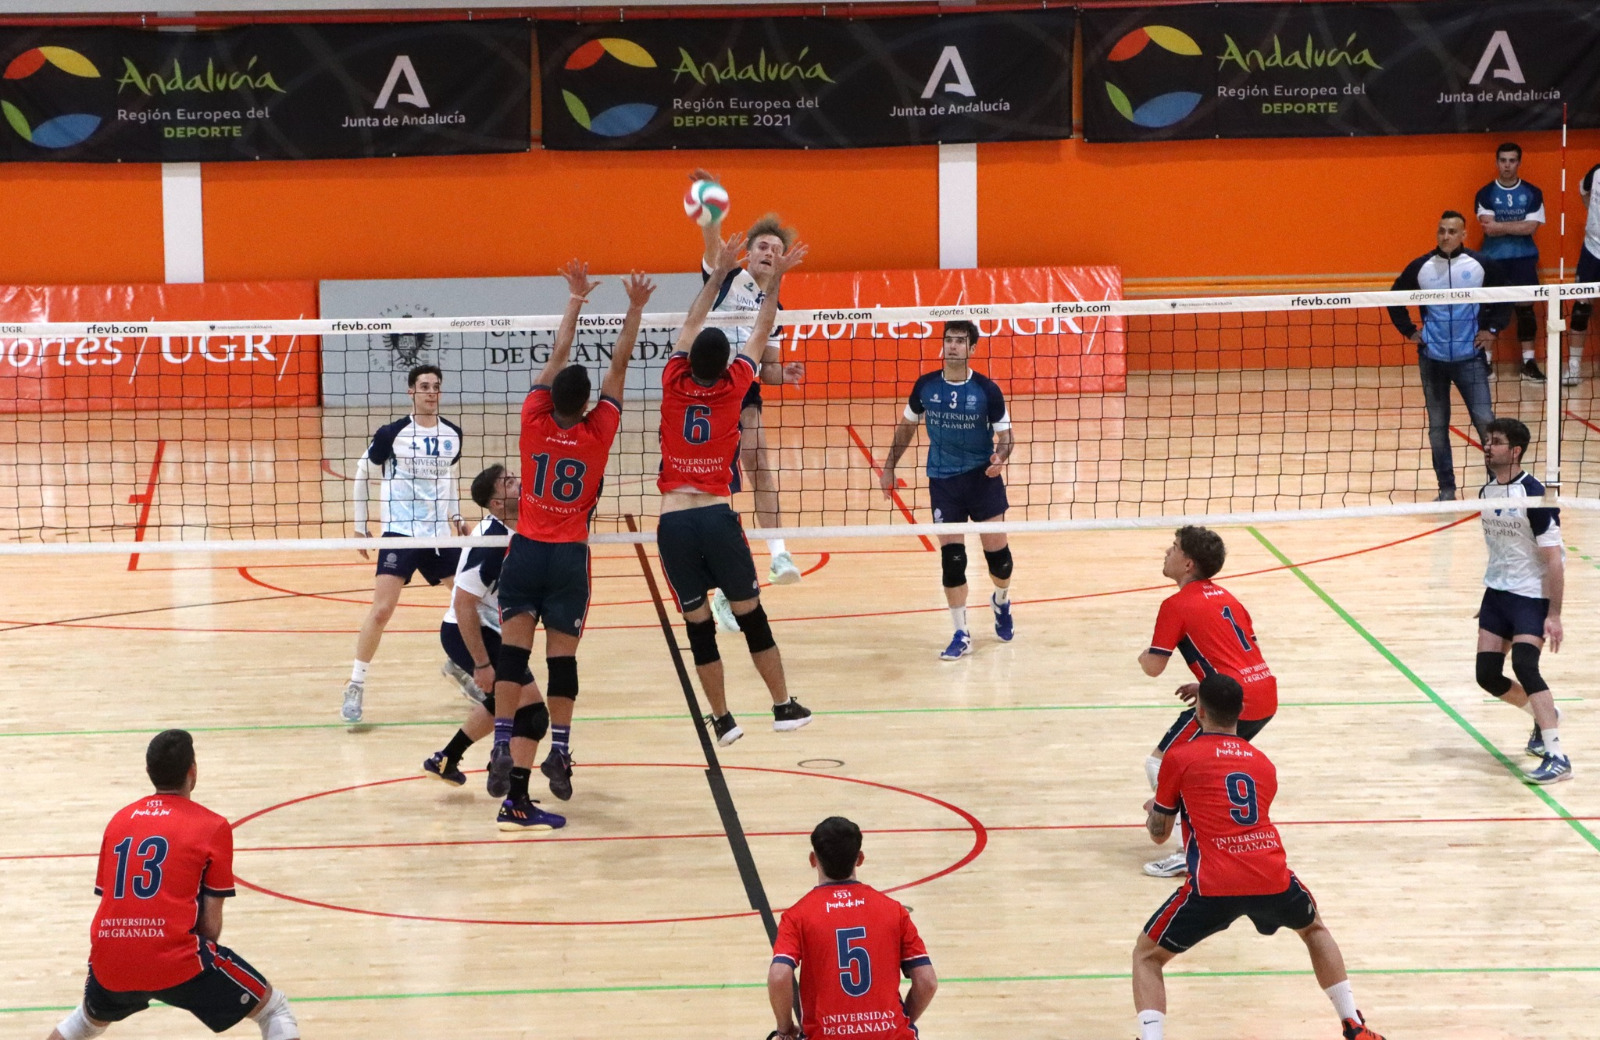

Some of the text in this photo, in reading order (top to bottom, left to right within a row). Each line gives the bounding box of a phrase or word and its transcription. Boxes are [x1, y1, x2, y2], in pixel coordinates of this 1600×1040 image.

[1216, 32, 1384, 73] Andalucía
[671, 46, 836, 86] Andalucía
[116, 55, 287, 97] Andalucía
[1217, 83, 1367, 100] Región Europea del
[1437, 86, 1561, 104] Junta de Andalucía
[673, 96, 820, 114] Región Europea del
[890, 99, 1011, 118] Junta de Andalucía
[1261, 102, 1338, 114] DEPORTE
[117, 105, 270, 124] Región Europea del
[341, 110, 466, 129] Junta de Andalucía
[674, 114, 792, 128] DEPORTE 2021
[163, 125, 242, 139] DEPORTE
[1410, 291, 1471, 300] deportes UGR
[1534, 285, 1594, 297] rfeb.com
[1290, 295, 1351, 306] rfevb.com
[813, 311, 872, 321] rfevb.com
[929, 307, 990, 317] deportes UGR
[1051, 303, 1111, 314] rfevb.com
[87, 324, 148, 334] rfevb.com
[331, 321, 392, 332] rfevb.com
[450, 318, 511, 329] deportes UGR
[579, 316, 626, 327] fevb.co
[0, 335, 278, 368] ortes UGR
[490, 347, 524, 364] DE
[949, 391, 958, 409] 3
[683, 404, 711, 445] 6
[424, 437, 440, 456] 12
[668, 455, 724, 466] UNIVERSIDAD
[531, 452, 587, 502] 18
[1221, 606, 1251, 652] 1
[1225, 771, 1258, 826] 9
[1228, 840, 1280, 854] GRANADA
[113, 835, 169, 899] 13
[833, 891, 852, 899] 1531
[100, 918, 166, 927] UNIVERSIDAD
[98, 928, 165, 938] DE GRANADA
[836, 926, 872, 997] 5
[822, 1010, 895, 1025] UNIVERSIDAD
[823, 1021, 897, 1035] DE GRANADA
